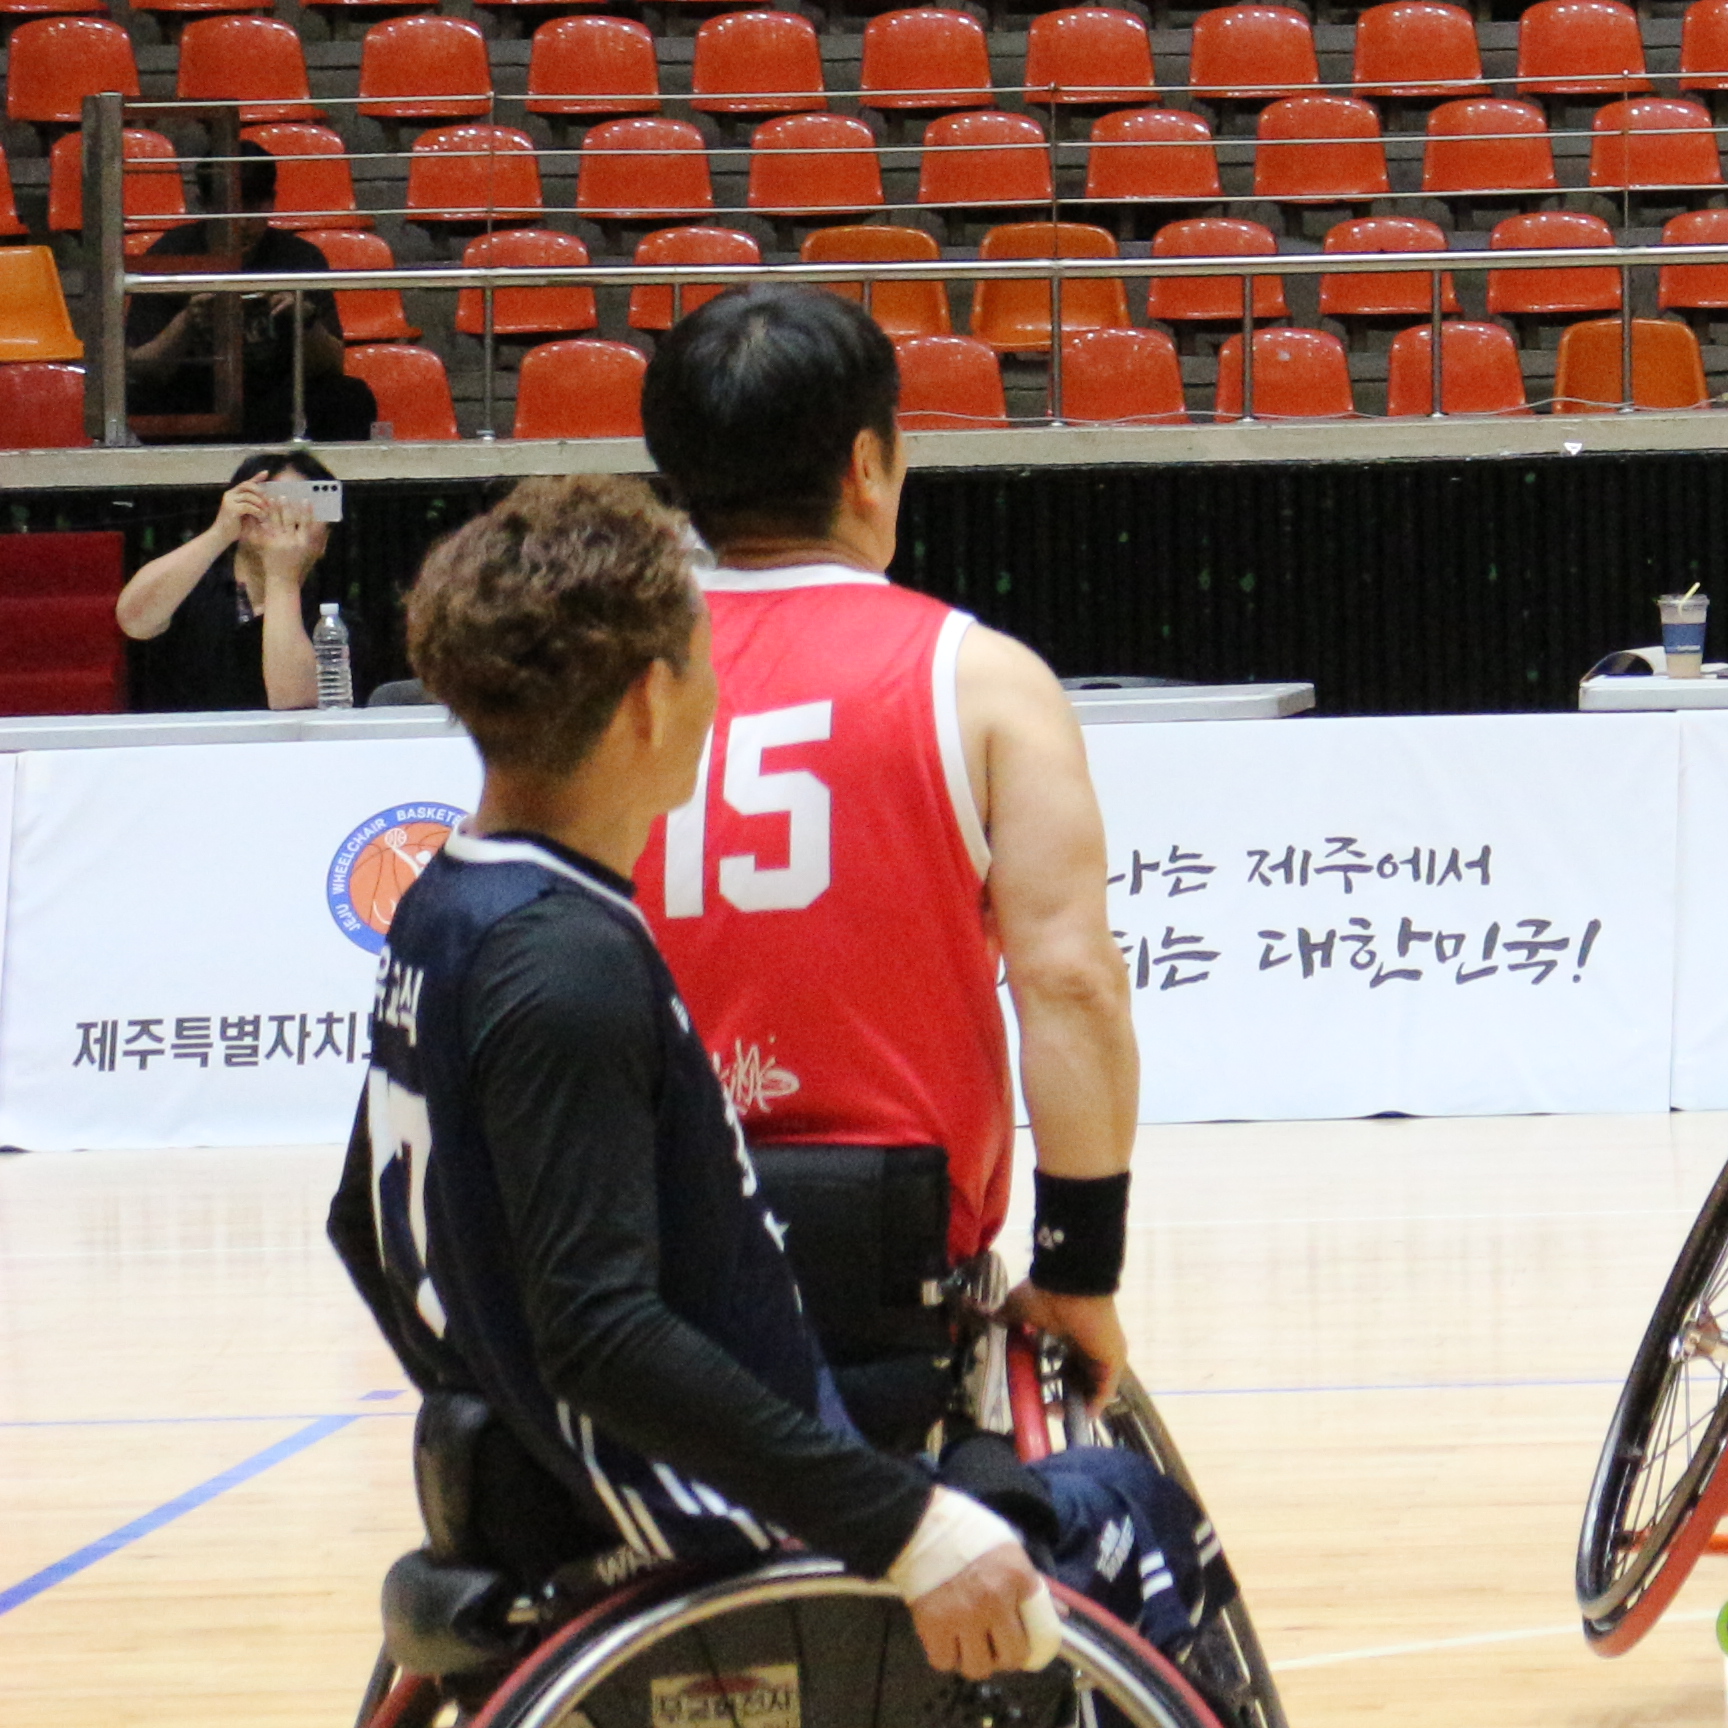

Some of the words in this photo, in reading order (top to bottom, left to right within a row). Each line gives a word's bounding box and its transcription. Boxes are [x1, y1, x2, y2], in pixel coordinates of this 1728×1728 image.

[664, 700, 833, 919] 15
[332, 817, 387, 896] WHEELCHAIR
[1246, 836, 1493, 896] 제주에서
[335, 903, 362, 932] JEJU
[1256, 915, 1602, 990] 대한민국!
[72, 1011, 374, 1072] 제주특별자치
